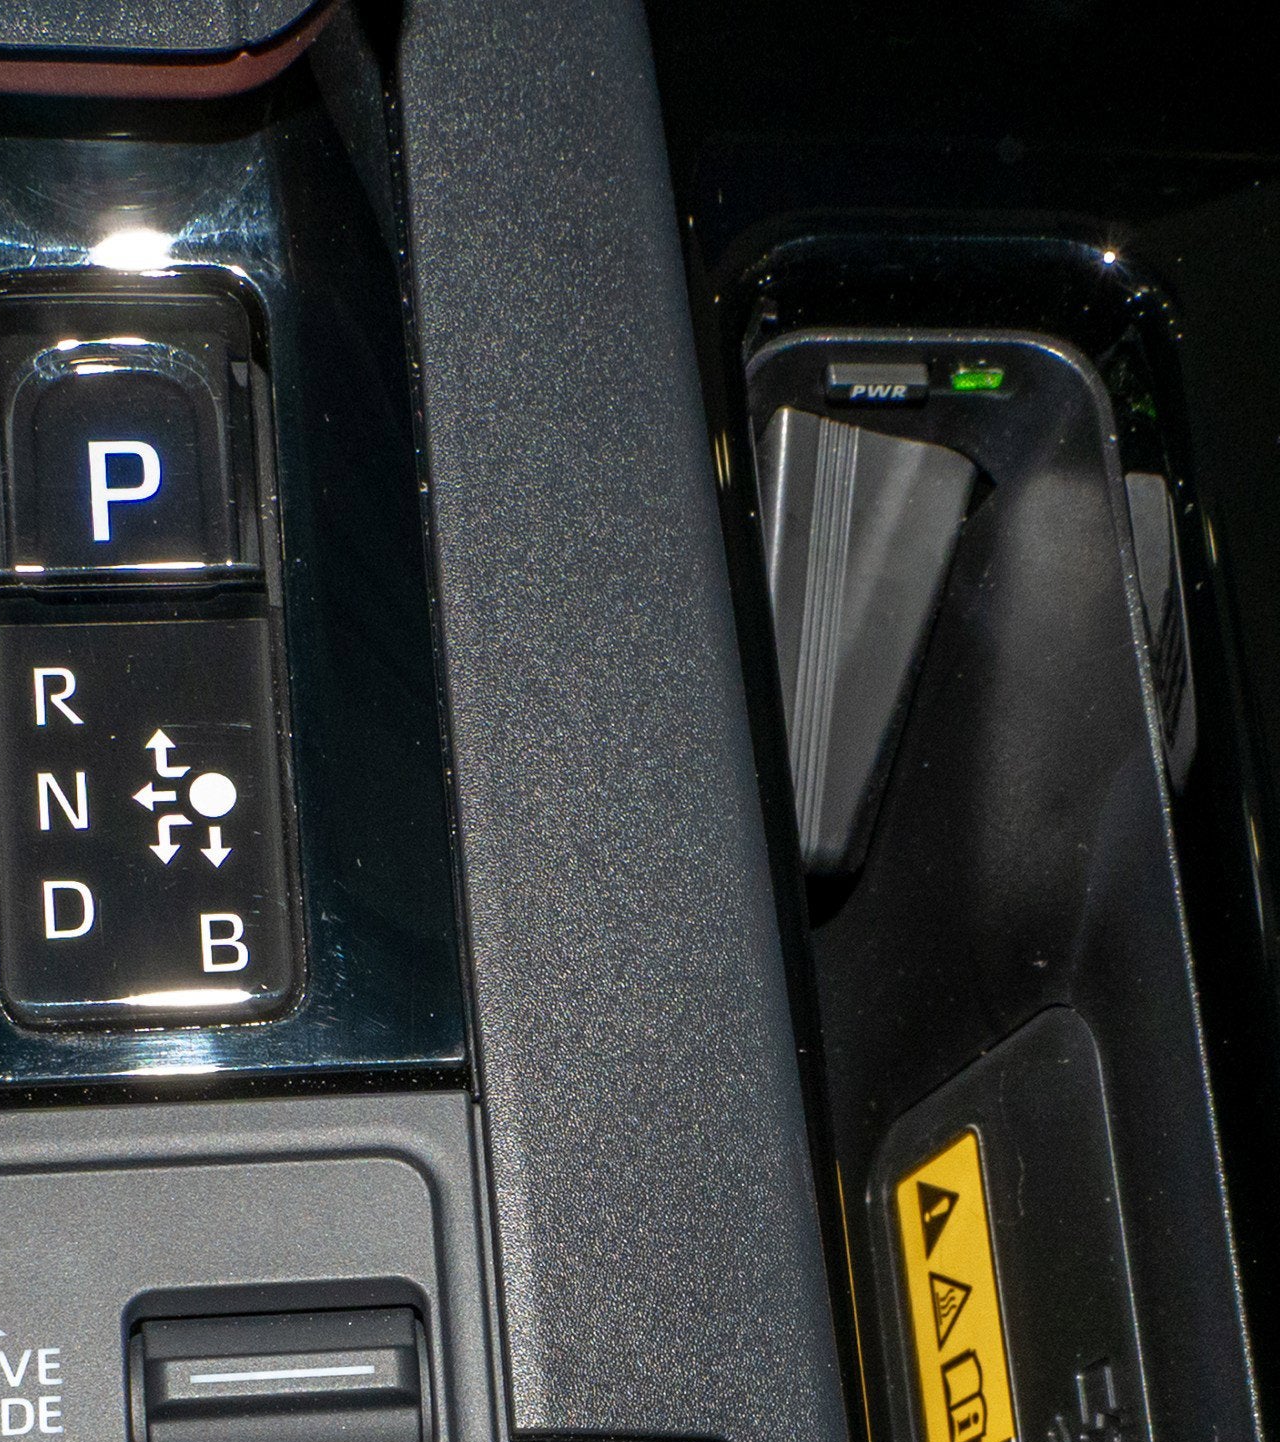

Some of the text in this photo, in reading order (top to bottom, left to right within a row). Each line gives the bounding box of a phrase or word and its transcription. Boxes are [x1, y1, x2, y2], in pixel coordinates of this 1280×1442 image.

[849, 384, 908, 399] PWR
[88, 440, 162, 541] P
[32, 667, 84, 726] R
[37, 772, 90, 831] N
[43, 880, 95, 939] D
[200, 913, 250, 972] B
